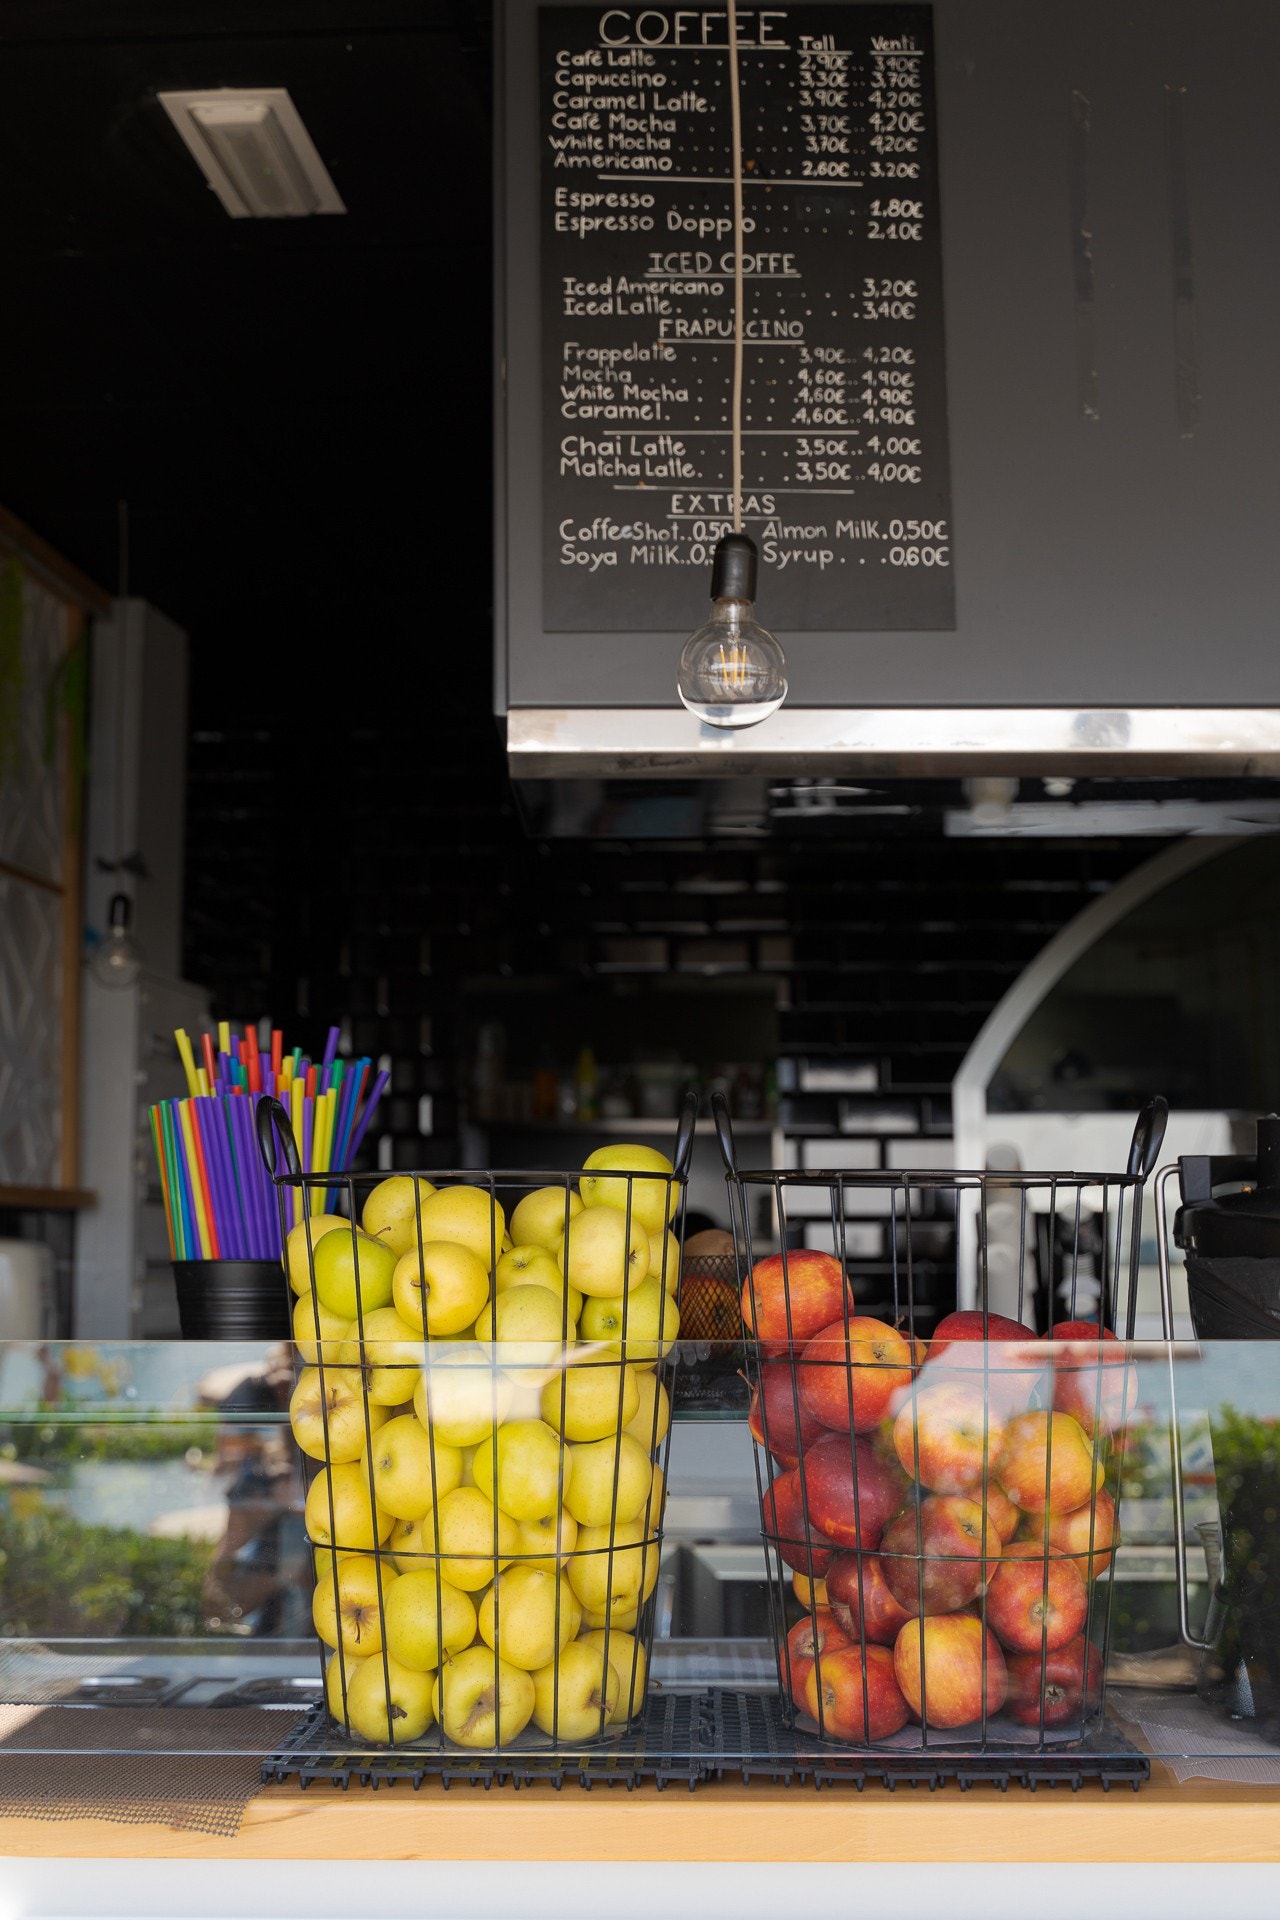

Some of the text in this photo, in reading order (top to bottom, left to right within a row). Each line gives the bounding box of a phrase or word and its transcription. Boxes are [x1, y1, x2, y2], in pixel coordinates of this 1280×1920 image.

[599, 10, 788, 45] COFFEE
[799, 34, 916, 51] Tall Venti
[556, 50, 603, 67] Café
[608, 49, 656, 67] Latte
[800, 55, 849, 71] 2,90€
[555, 69, 922, 94] Capuccino 3,30€ 3,70€
[553, 90, 922, 113] Caramel Latte 3,90€ 4,20€
[552, 111, 926, 134] Café Mocha 3,70€ 4,20€
[548, 132, 918, 155] White Mocha 3,70€ 4,20€
[554, 151, 921, 179] Americano 2,60€ 3,20€
[555, 187, 925, 219] Espresso 1,80€
[555, 210, 923, 241] Espresso Doppo 2,10€
[648, 252, 798, 274] ICED COFFE
[563, 276, 919, 298] Iced Americano 3,20€
[563, 295, 916, 320] Iced Latte 3,40€
[800, 347, 847, 364] 3,90€
[862, 346, 916, 365] 4,20€
[563, 365, 915, 388] Mocha 4,60€ 4,90€
[560, 384, 913, 406] White Mocha 4,60€ 4,90€
[561, 401, 917, 426] Caramel 4,60€ 4,90€
[561, 435, 922, 457] Chai Latte 3,50€ 4,00€
[560, 457, 922, 483] Matcha Latte 3,50€ 4,00€
[671, 494, 776, 515] EXTRAS
[761, 520, 828, 540] Almon
[889, 519, 949, 541] 0,50€
[560, 543, 618, 572] Soya
[763, 541, 950, 570] Syrup 0,60€
